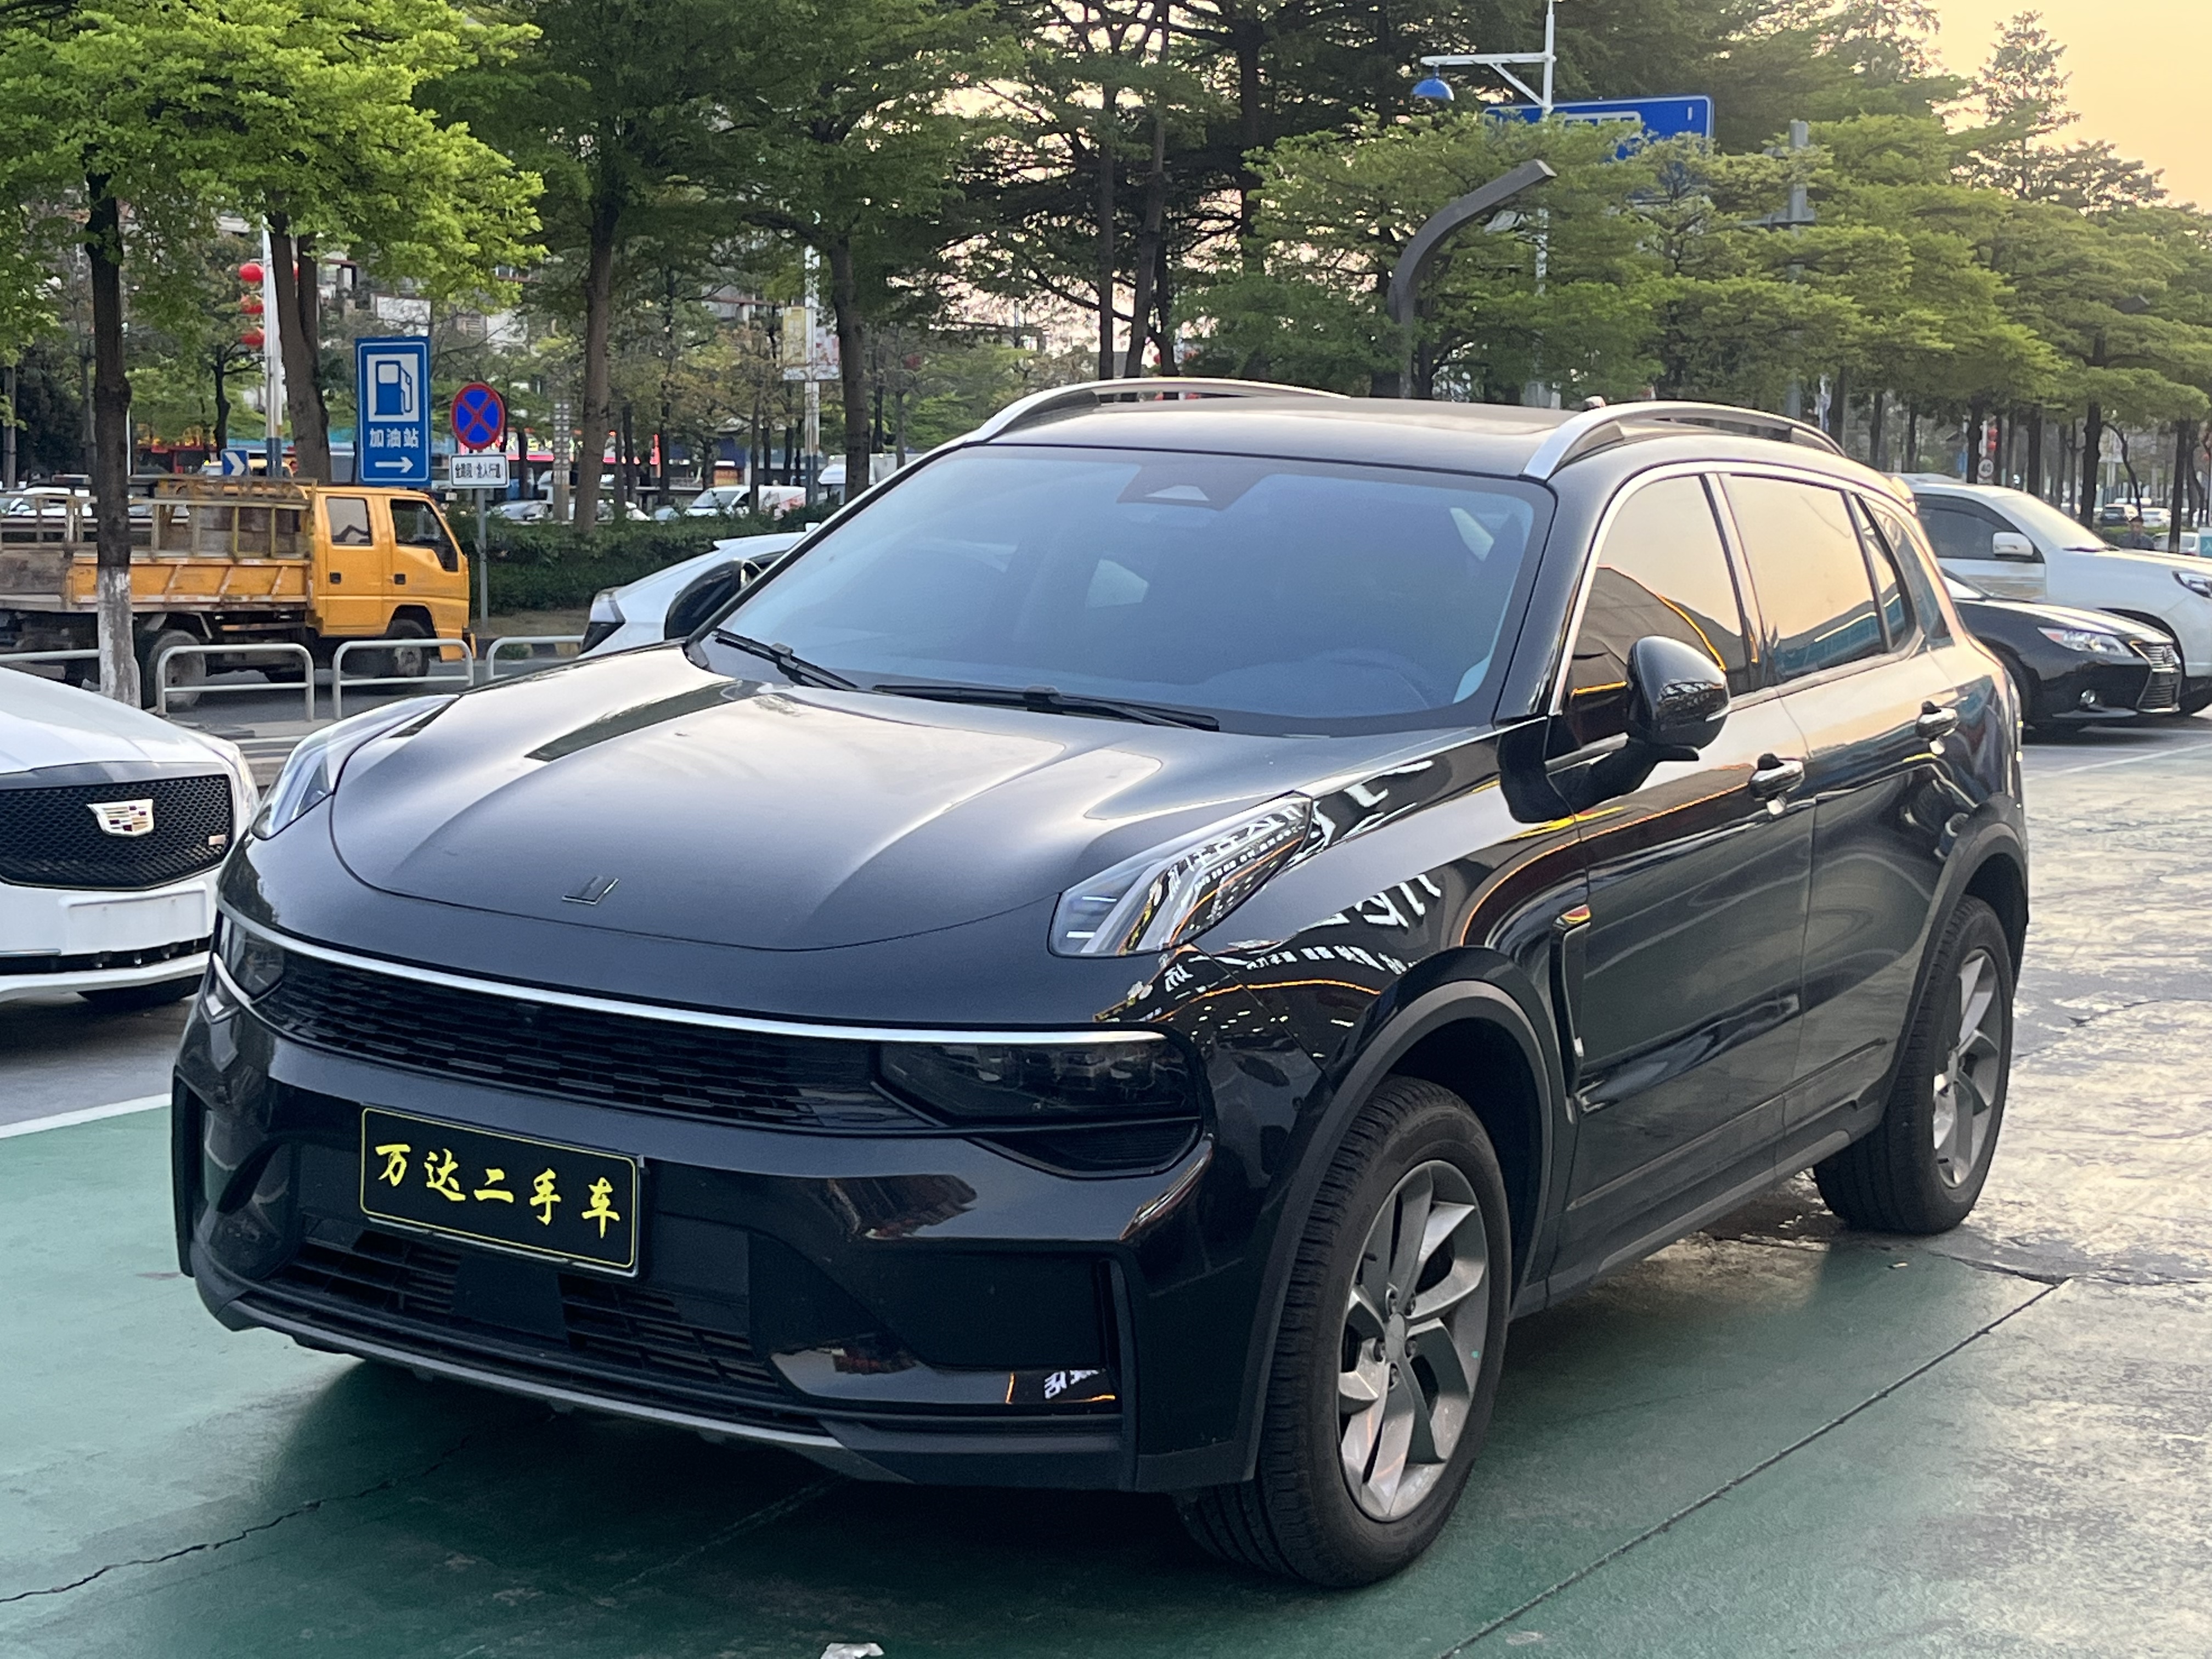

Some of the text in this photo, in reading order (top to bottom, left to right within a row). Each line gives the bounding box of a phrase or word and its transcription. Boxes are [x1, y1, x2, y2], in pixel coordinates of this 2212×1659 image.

[369, 427, 419, 448] 加油站
[1981, 462, 1991, 473] 40
[375, 1143, 620, 1238] 万达二手车
